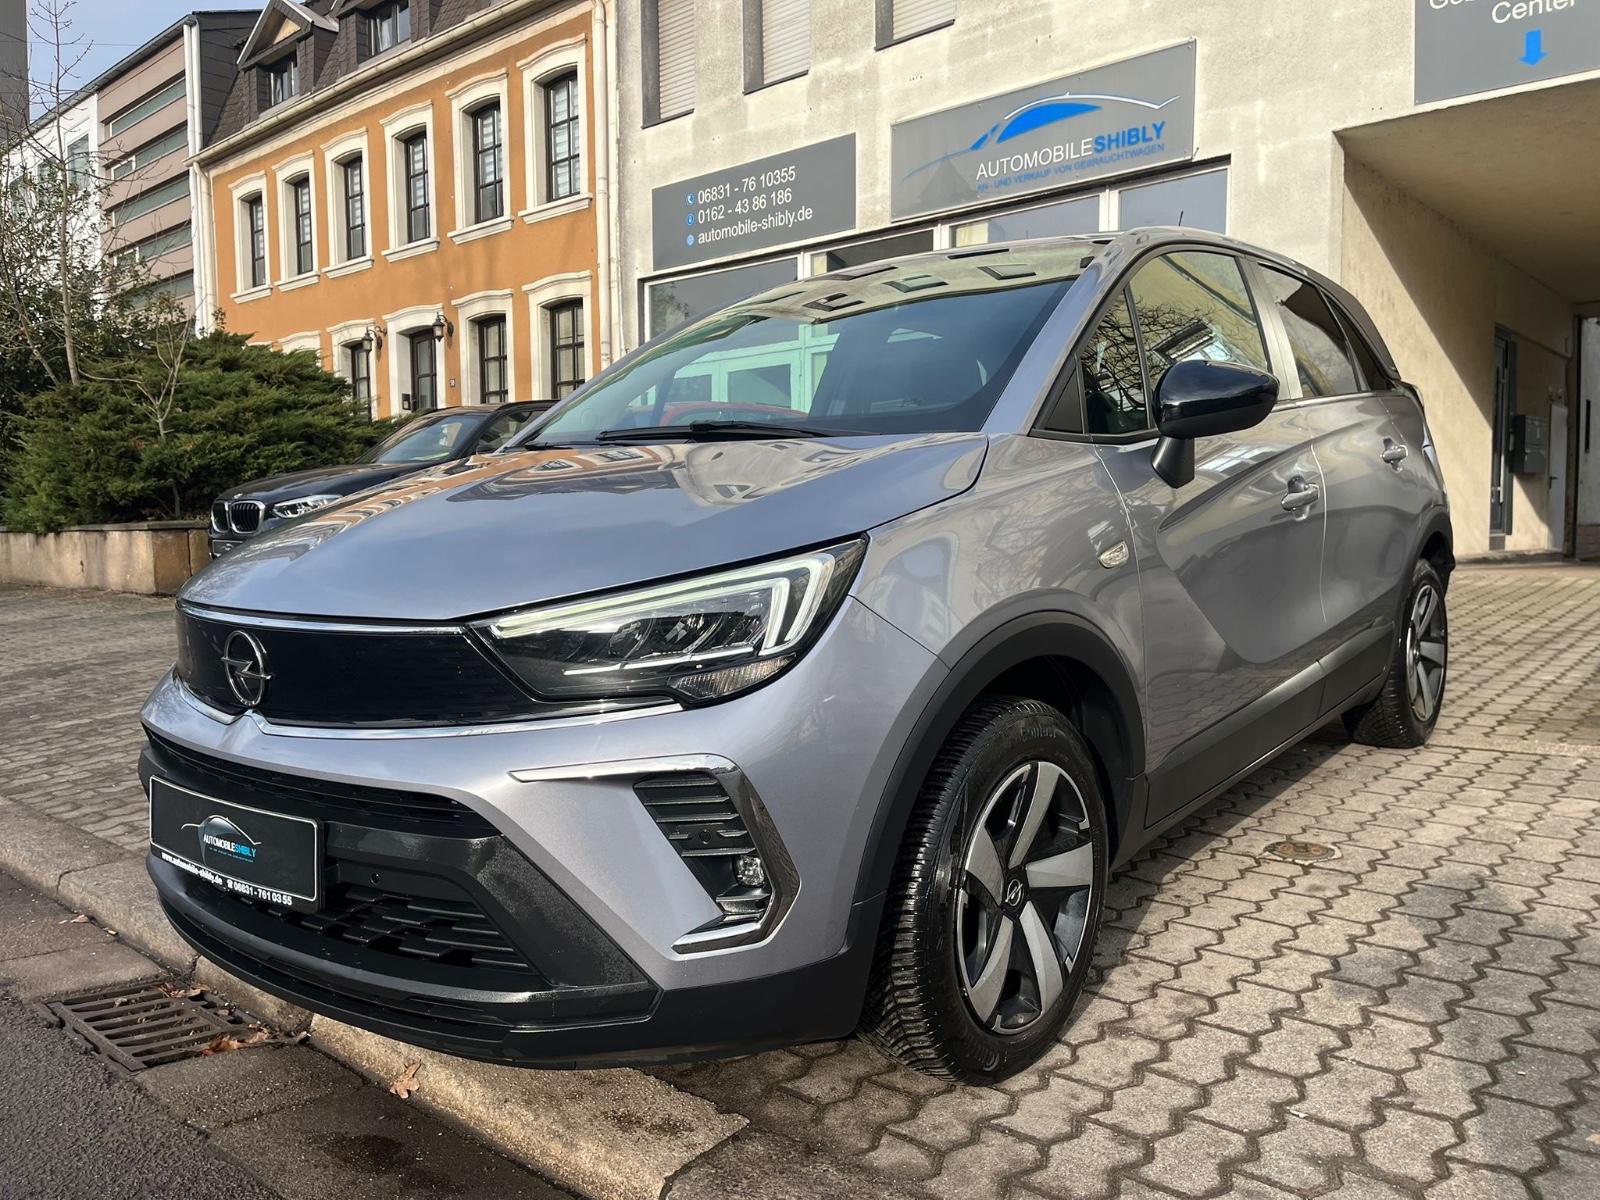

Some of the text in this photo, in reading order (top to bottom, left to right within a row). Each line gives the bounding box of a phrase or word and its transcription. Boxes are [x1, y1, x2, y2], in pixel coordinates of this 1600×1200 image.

[1014, 168, 1052, 183] VERKAUF
[1055, 163, 1073, 175] VON
[1074, 143, 1165, 172] GEBRAUCHTWAGEN
[698, 183, 730, 205] 06831
[742, 176, 757, 193] 76
[760, 166, 796, 188] 10355
[698, 205, 725, 224] 0162
[735, 198, 749, 215] 43
[752, 194, 767, 211] 86
[771, 188, 792, 206] 186
[698, 205, 813, 244] automobile-shibly.de
